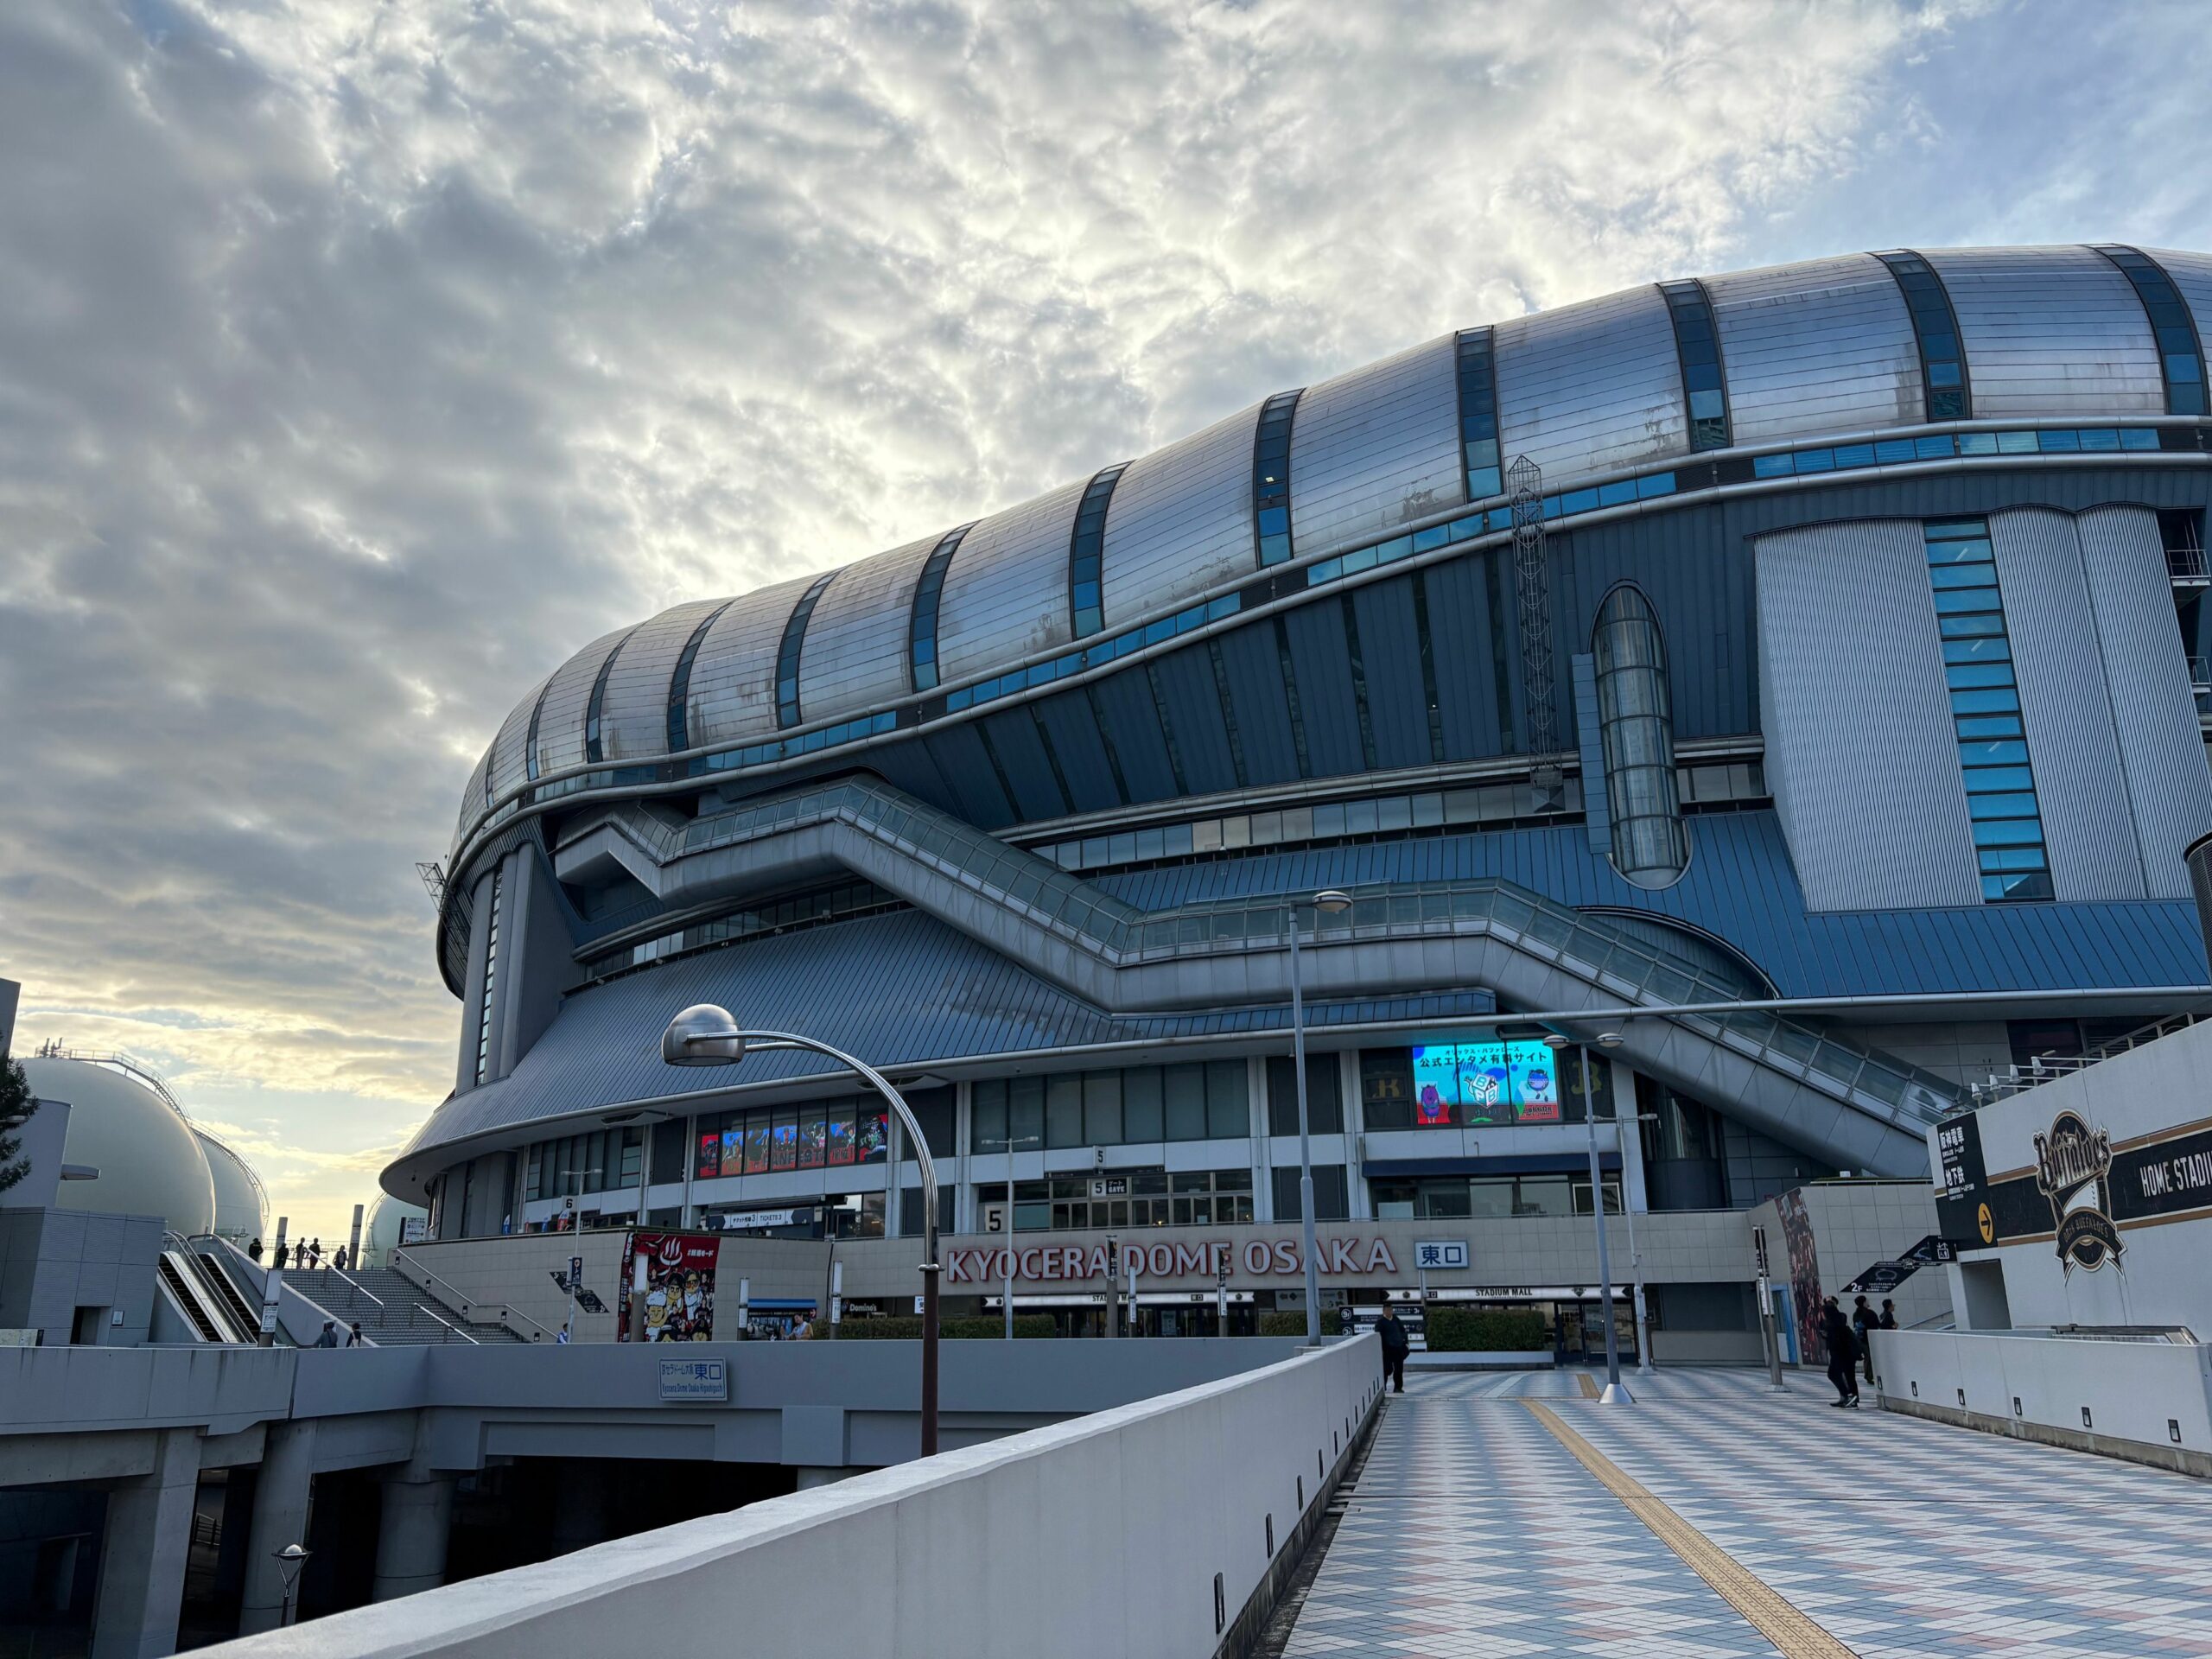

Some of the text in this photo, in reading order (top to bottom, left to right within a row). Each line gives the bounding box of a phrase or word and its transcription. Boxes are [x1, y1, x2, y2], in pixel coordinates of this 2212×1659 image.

[1097, 1150, 1103, 1163] 5
[2139, 1160, 2174, 1198] HOME
[1095, 1182, 1103, 1193] 5
[566, 1198, 574, 1209] 6
[989, 1211, 1001, 1231] 5
[947, 1244, 1108, 1282] KYOCERA
[1122, 1241, 1233, 1277] DOME
[1243, 1238, 1398, 1275] OSAKA
[1421, 1245, 1462, 1265] 東口
[1475, 1287, 1533, 1297] STADIUM MALL
[1851, 1282, 1863, 1293] 2F
[849, 1302, 877, 1312] Domino's
[694, 1363, 722, 1381] 東口
